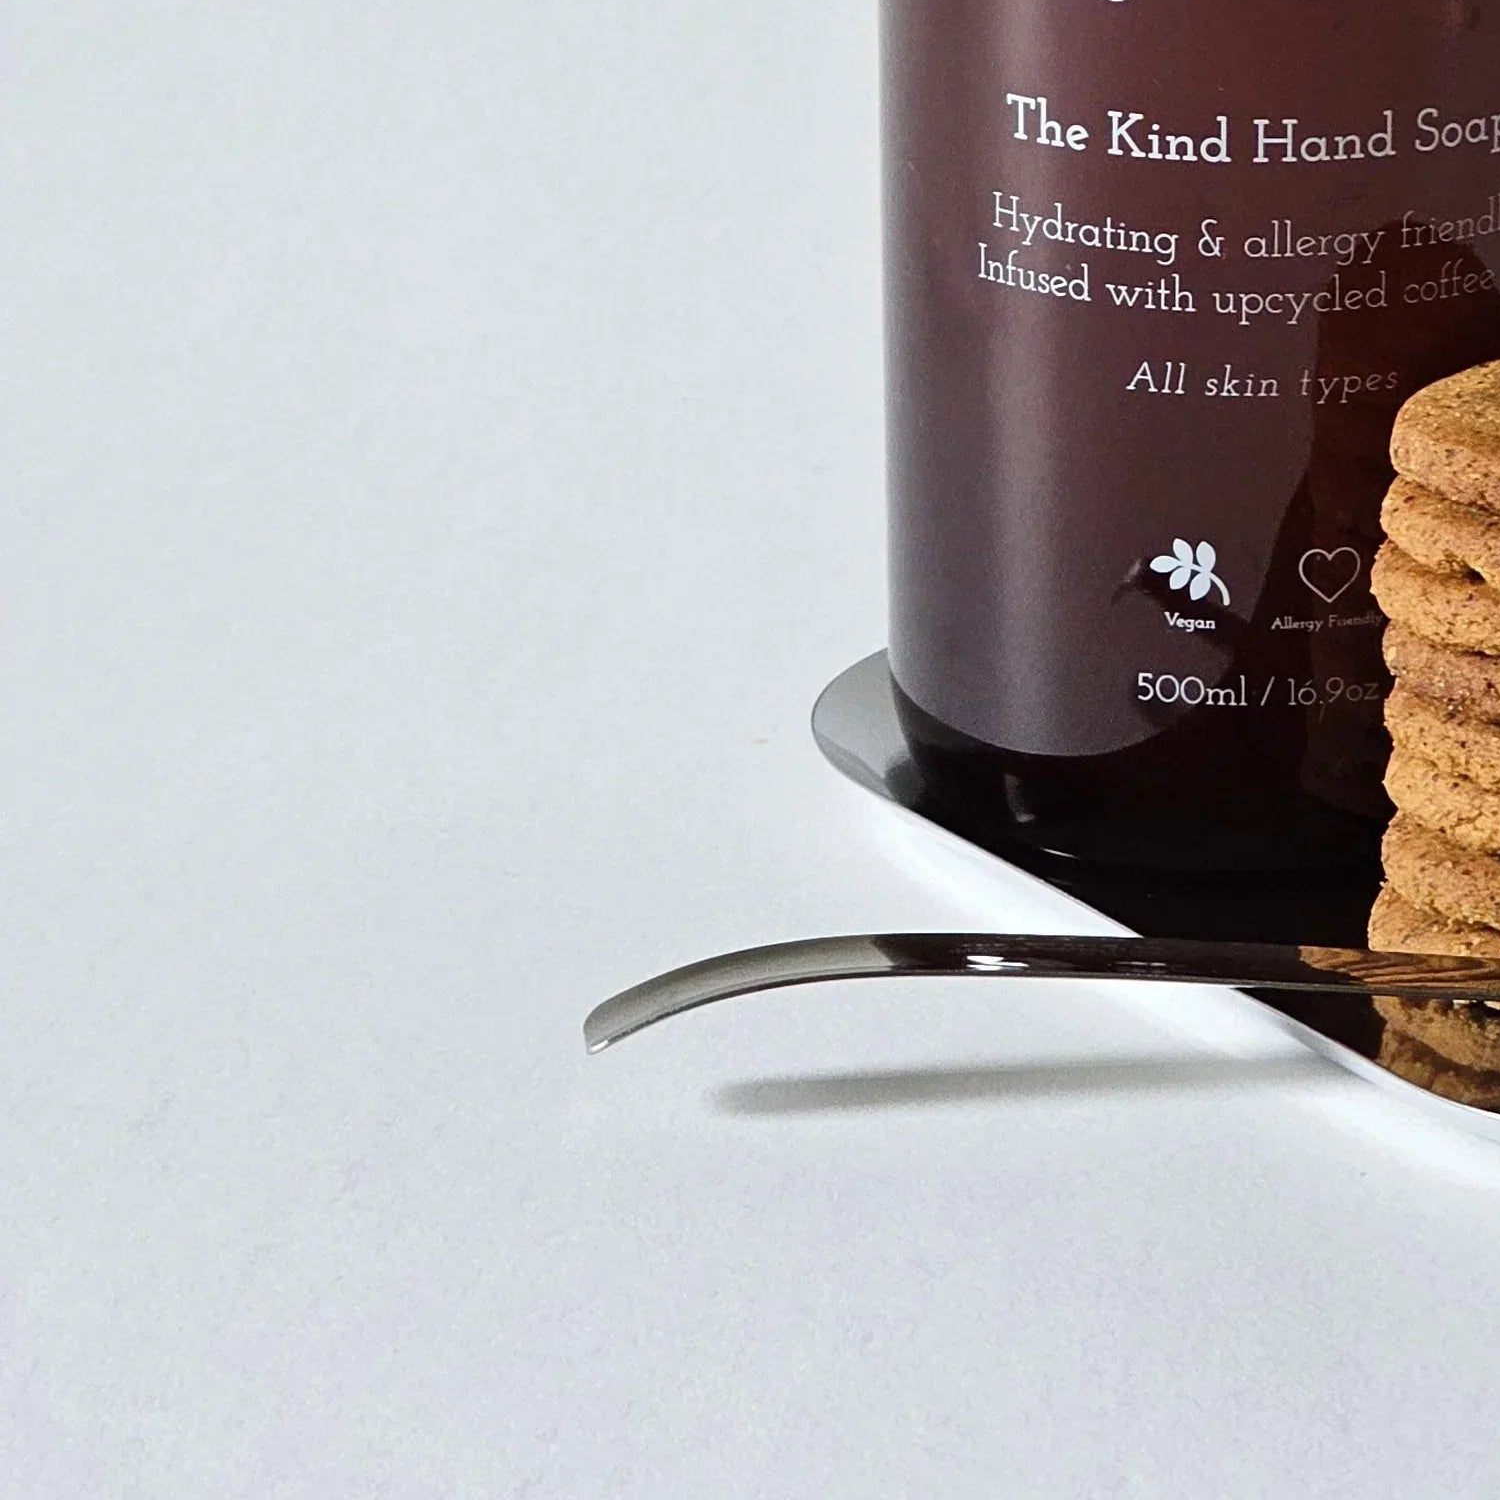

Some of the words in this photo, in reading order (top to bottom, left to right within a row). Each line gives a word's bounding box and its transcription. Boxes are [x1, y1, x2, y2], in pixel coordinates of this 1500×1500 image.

[1007, 93, 1089, 151] The
[1107, 110, 1231, 163] Kind
[1253, 110, 1396, 164] Hand
[992, 192, 1178, 263] Hydrating
[1198, 219, 1225, 257] &
[1243, 217, 1385, 266] allergy
[977, 243, 1091, 302] Infused
[1105, 274, 1197, 313] with
[1212, 274, 1388, 326] upcycled
[1402, 260, 1494, 305] coffee
[1126, 361, 1187, 395] All
[1204, 365, 1280, 398] skin
[1300, 367, 1399, 404] types
[1164, 611, 1216, 633] Vegan
[1271, 616, 1325, 633] Allergy
[1137, 672, 1248, 706] 500ml
[1260, 675, 1275, 707] /
[1287, 676, 1380, 706] 16.9oz
